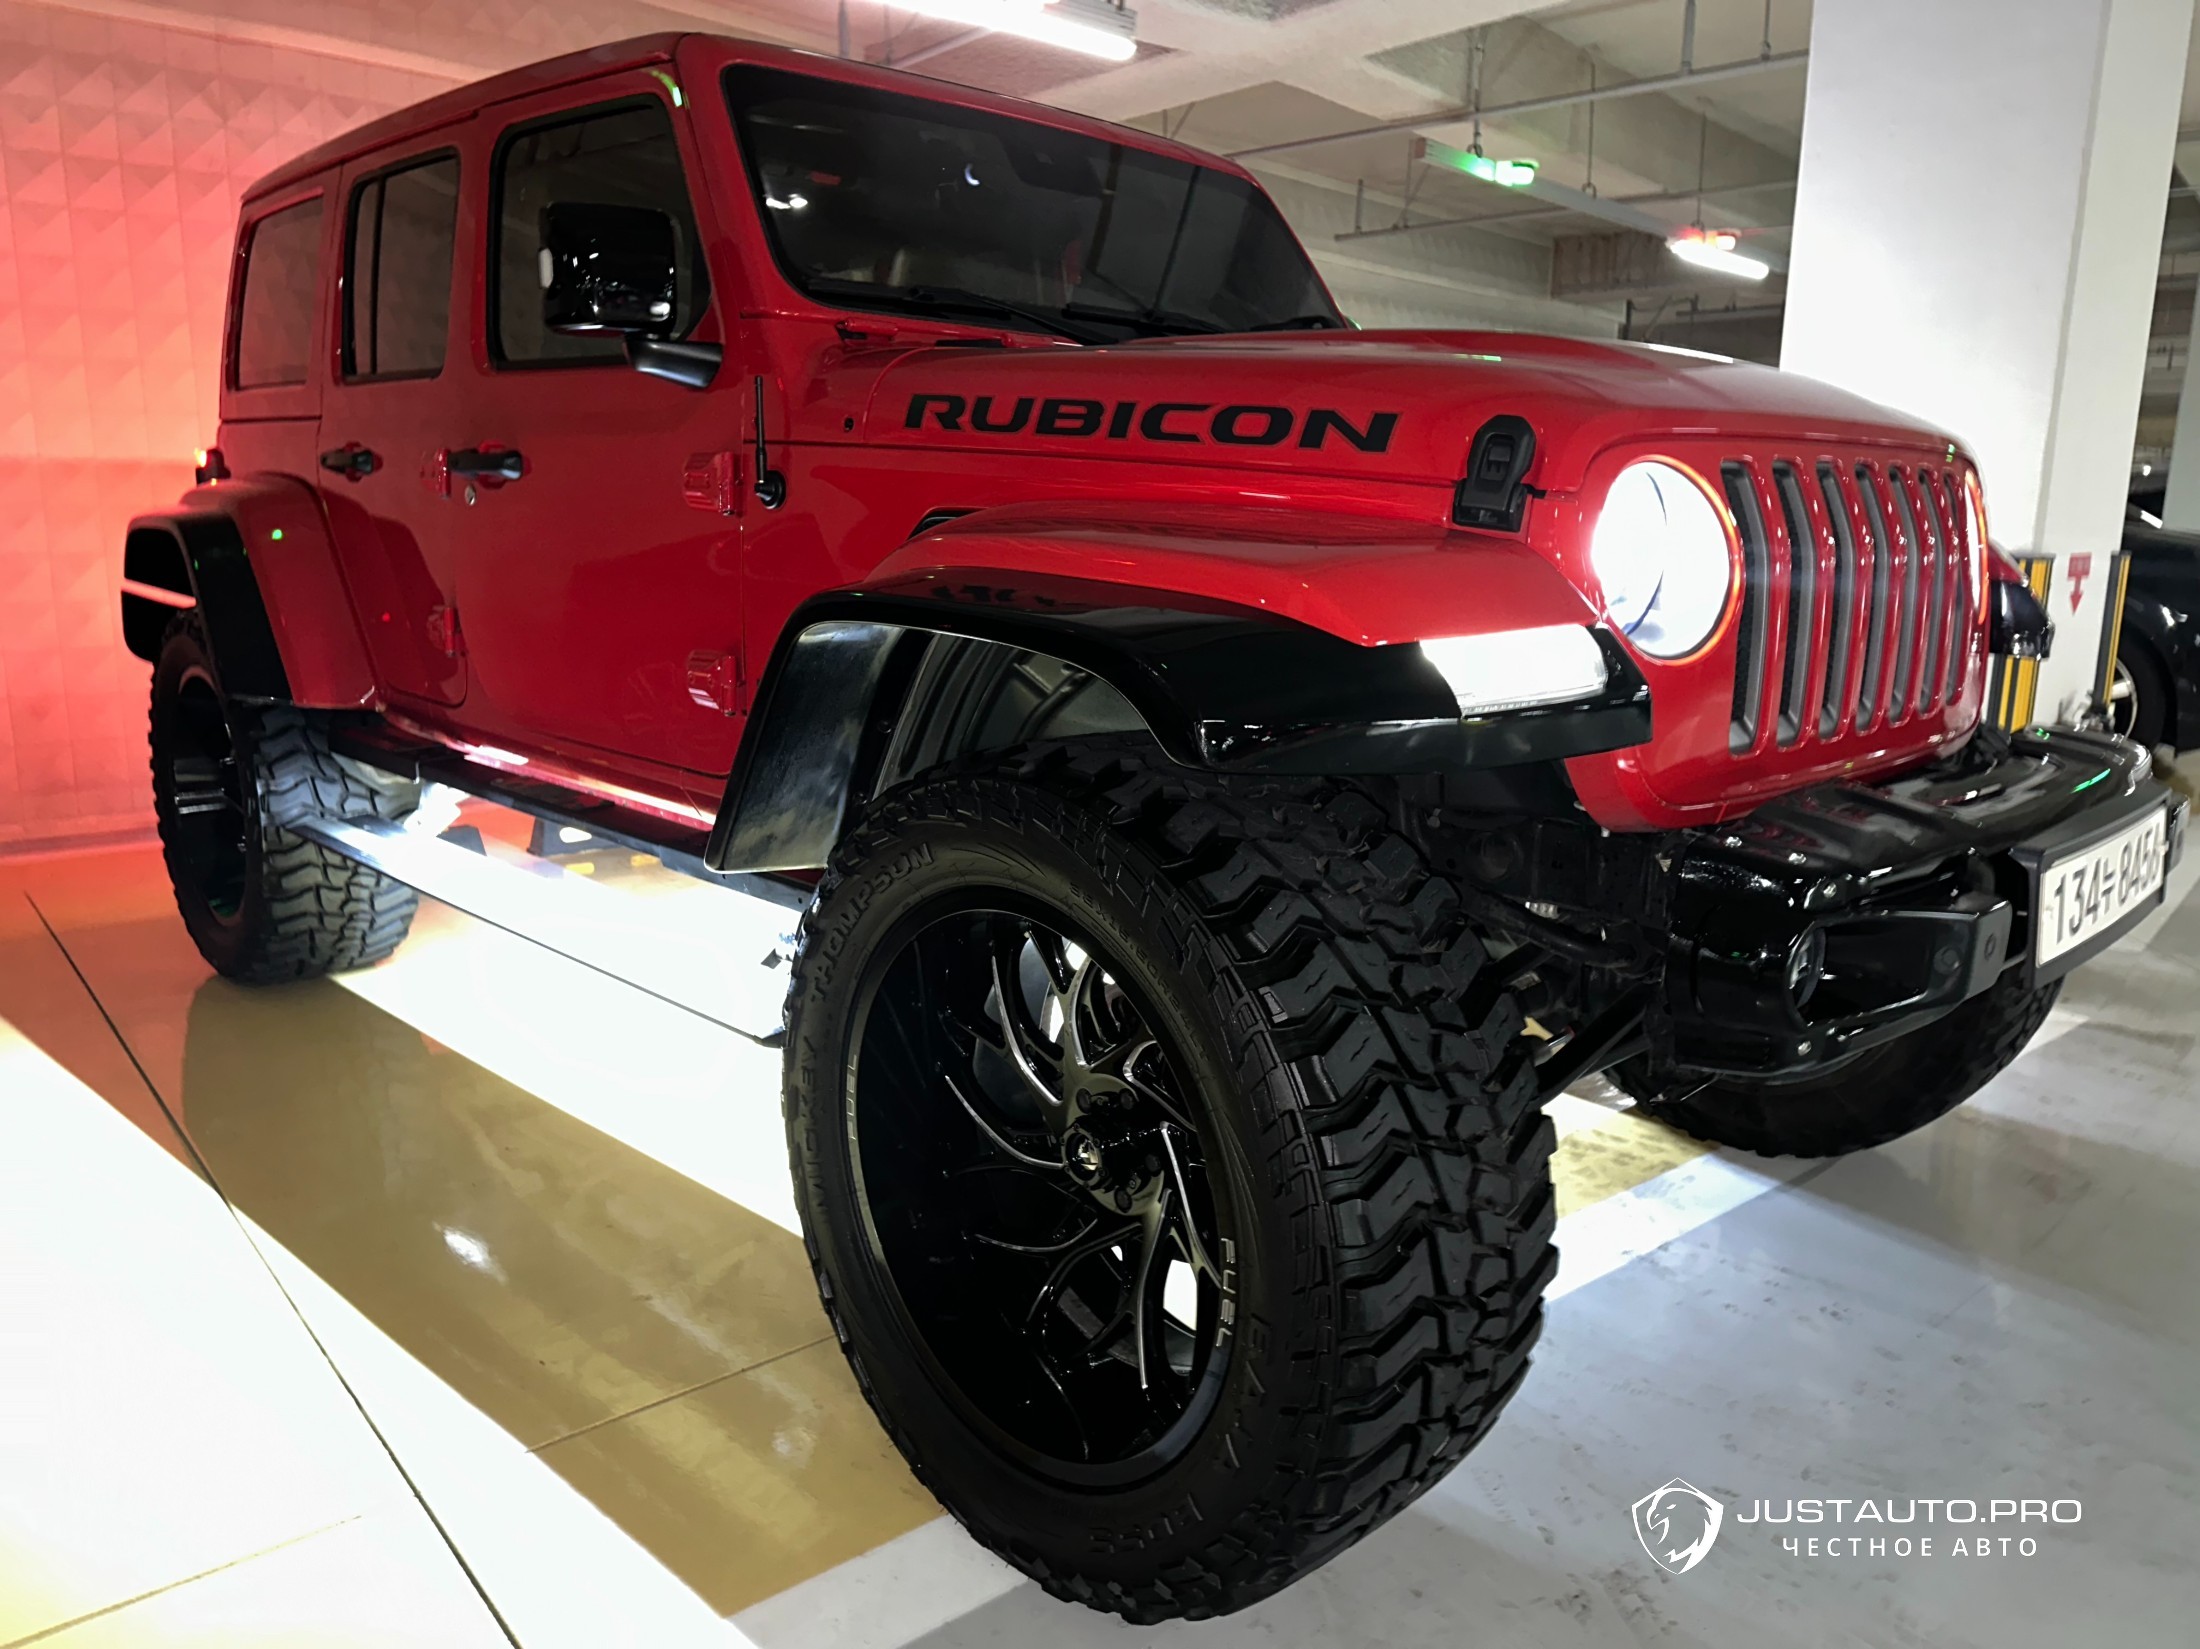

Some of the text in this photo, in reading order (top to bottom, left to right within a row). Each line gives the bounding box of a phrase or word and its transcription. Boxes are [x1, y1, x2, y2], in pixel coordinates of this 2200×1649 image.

[904, 393, 1399, 453] RUBICON
[811, 842, 935, 1003] THOMPSON
[846, 1054, 858, 1141] FUEL
[1216, 1238, 1237, 1347] FUEL
